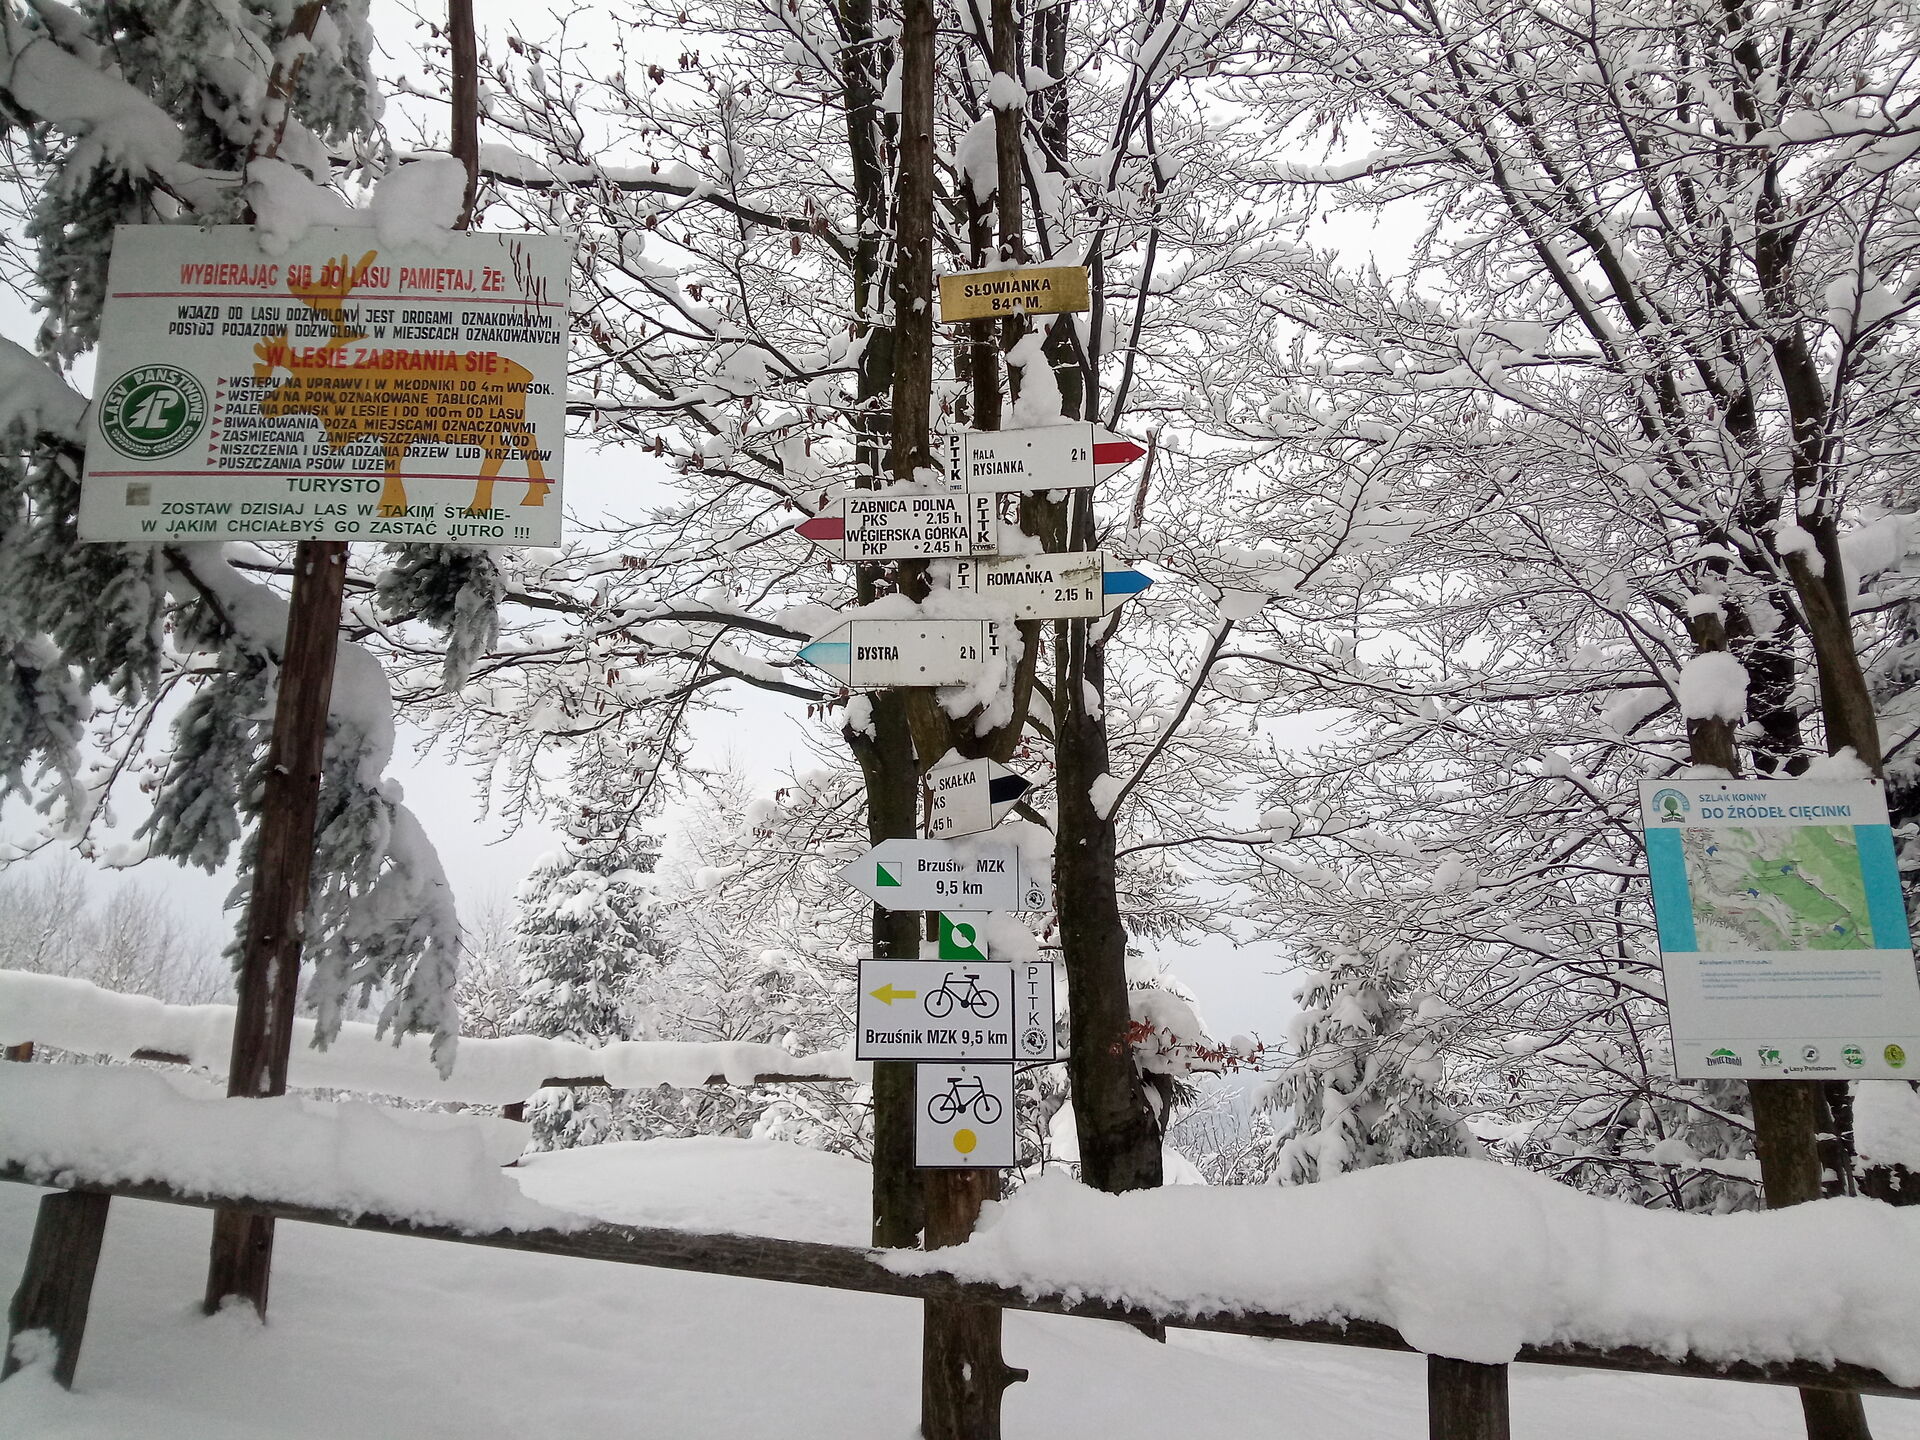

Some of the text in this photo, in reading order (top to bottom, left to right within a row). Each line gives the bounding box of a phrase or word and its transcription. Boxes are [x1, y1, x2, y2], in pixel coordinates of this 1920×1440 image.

[180, 263, 279, 289] WYBIERAJĄC
[320, 265, 342, 288] DO
[351, 266, 391, 289] LASU
[400, 267, 477, 293] PAMIĘTAJ,
[964, 278, 1051, 298] SŁOWIANKA
[1026, 295, 1043, 309] M.
[178, 305, 219, 320] WJAZD
[228, 306, 242, 320] DO
[251, 306, 280, 321] LASU
[365, 309, 395, 324] JEST
[402, 310, 453, 325] DROGAMI
[374, 326, 386, 339] W
[393, 326, 459, 341] MIEJSCACH
[466, 328, 560, 345] OZNAKOWANYCH
[267, 347, 284, 368] W
[290, 347, 348, 369] LESIE
[354, 348, 458, 372] ZABRANIA
[285, 377, 301, 389] NA
[375, 379, 388, 390] W
[393, 379, 455, 392] MŁODNIKI
[460, 380, 476, 392] DO
[284, 390, 300, 402] NA
[339, 392, 428, 405] OZNAKOWANE
[436, 393, 503, 406] TABLICAMI
[225, 403, 278, 415] PALENIA
[282, 404, 328, 416] OGNISK
[334, 405, 346, 416] W
[351, 405, 388, 417] LESIE
[402, 406, 419, 418] DO
[466, 407, 484, 419] OD
[489, 408, 524, 420] LASU
[223, 417, 319, 429] BIWAKOWANIA
[324, 418, 357, 430] POZA
[364, 418, 438, 431] MIEJSCAMI
[219, 444, 299, 457] NISZCZENIA
[312, 445, 400, 458] USZKADZANIA
[403, 447, 449, 459] DRZEW
[456, 447, 481, 459] LUB
[973, 448, 995, 461] HALA
[1071, 448, 1086, 461] 2 h
[218, 457, 302, 469] PUSZCZANIA
[351, 458, 396, 471] LUZEM
[973, 460, 1024, 476] RYSIANKA
[286, 478, 380, 493] TURYSTO
[161, 502, 233, 516] ZOSTAW
[240, 503, 304, 516] DZISIAJ
[314, 503, 347, 516] LAS
[357, 504, 373, 516] W
[383, 505, 434, 518] TAKIM
[851, 499, 955, 513] ŻABNICA DOLNA
[862, 511, 962, 527] PKS 2.15 h
[141, 520, 157, 532] W
[165, 520, 217, 533] JAKIM
[227, 517, 324, 533] CHCIAŁBYŚ
[334, 521, 360, 533] GO
[369, 520, 437, 536] ZASTAĆ
[447, 524, 504, 539] JUTRO
[847, 526, 969, 542] WĘGIERSKA GÓRKA
[862, 541, 962, 555] PKP 2.45 h
[987, 570, 1054, 586] ROMANKA
[1054, 588, 1093, 602] 2.15 h
[857, 646, 899, 661] BYSTRA
[960, 646, 976, 659] 2 h
[939, 771, 976, 791] SKAŁKA
[1699, 793, 1767, 802] SZLAK KONNY
[1701, 807, 1724, 819] DO
[1789, 805, 1851, 820] CIĘCINKI
[946, 816, 952, 829] h
[976, 859, 1005, 873] MZK
[936, 881, 983, 896] 9,5 km
[866, 1029, 923, 1044] Brzuśnik
[927, 1029, 957, 1044] MZK
[961, 1030, 983, 1046] 9,5
[988, 1030, 1008, 1045] km
